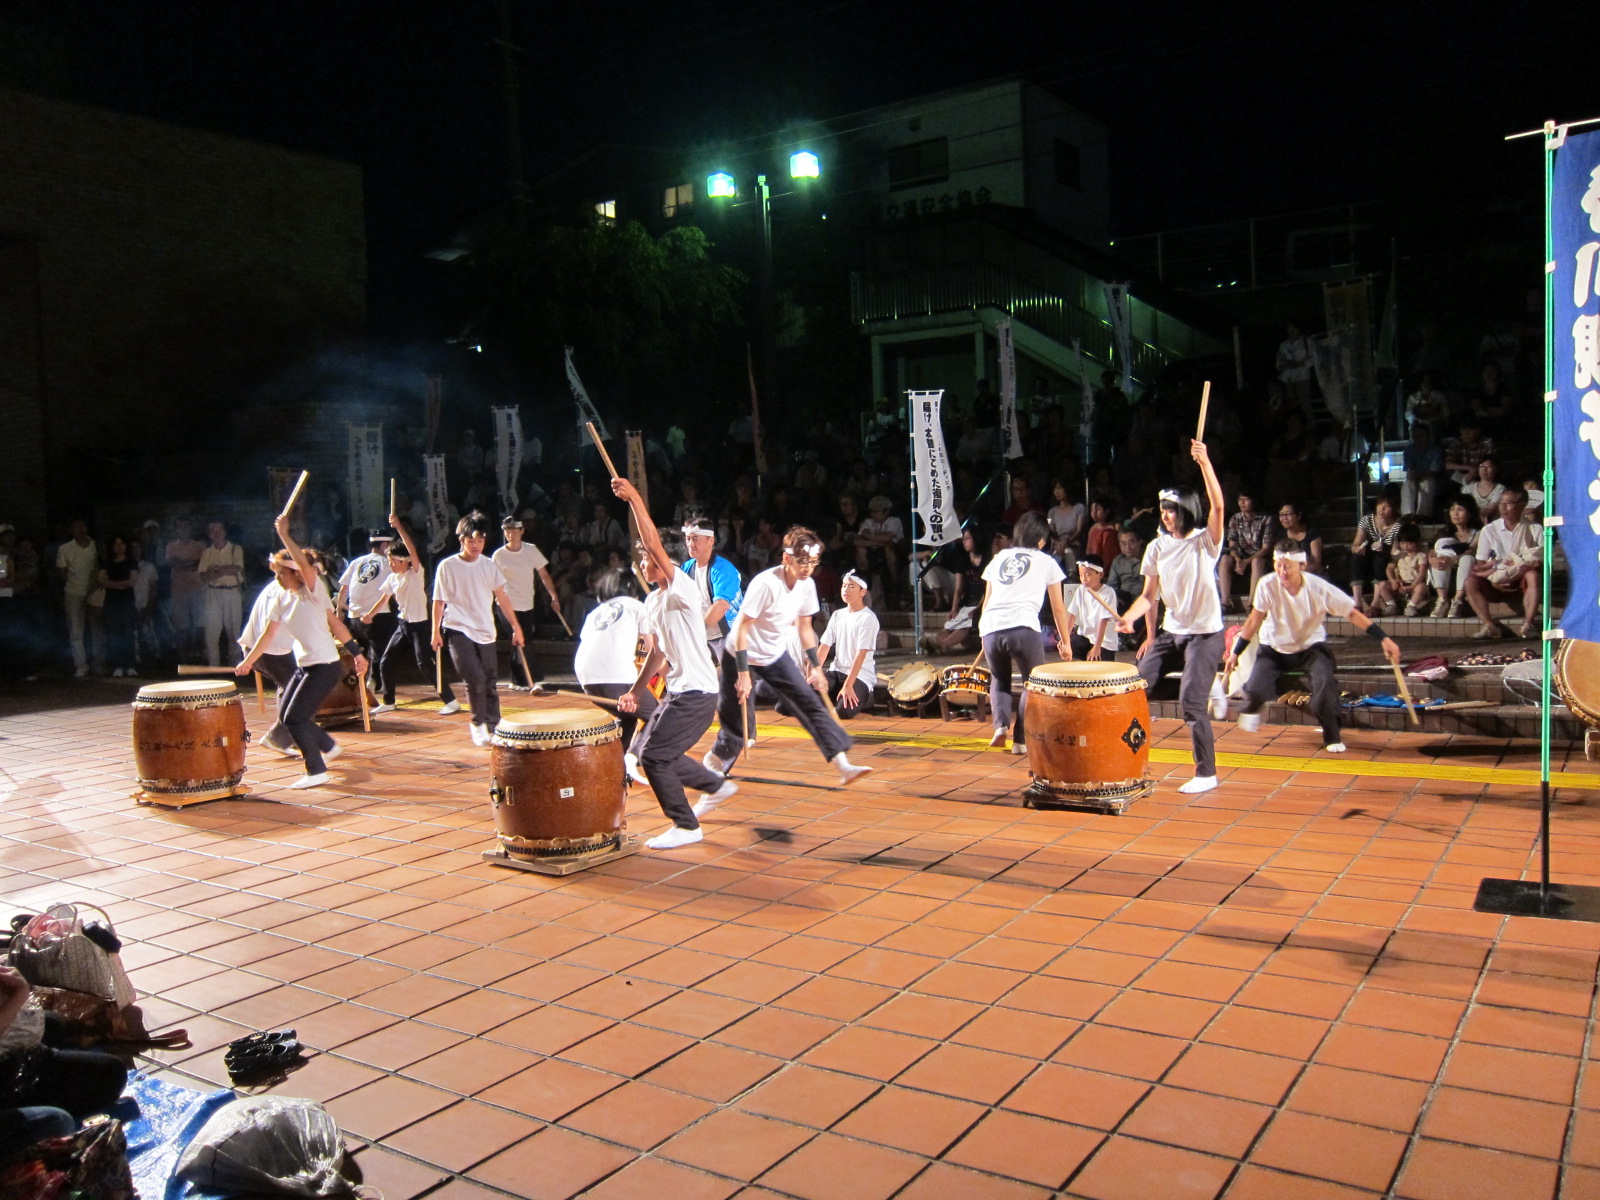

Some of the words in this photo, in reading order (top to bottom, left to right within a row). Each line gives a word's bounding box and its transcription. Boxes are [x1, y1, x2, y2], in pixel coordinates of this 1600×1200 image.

[922, 401, 943, 542] 届け、太鼓にこめた復興への願い
